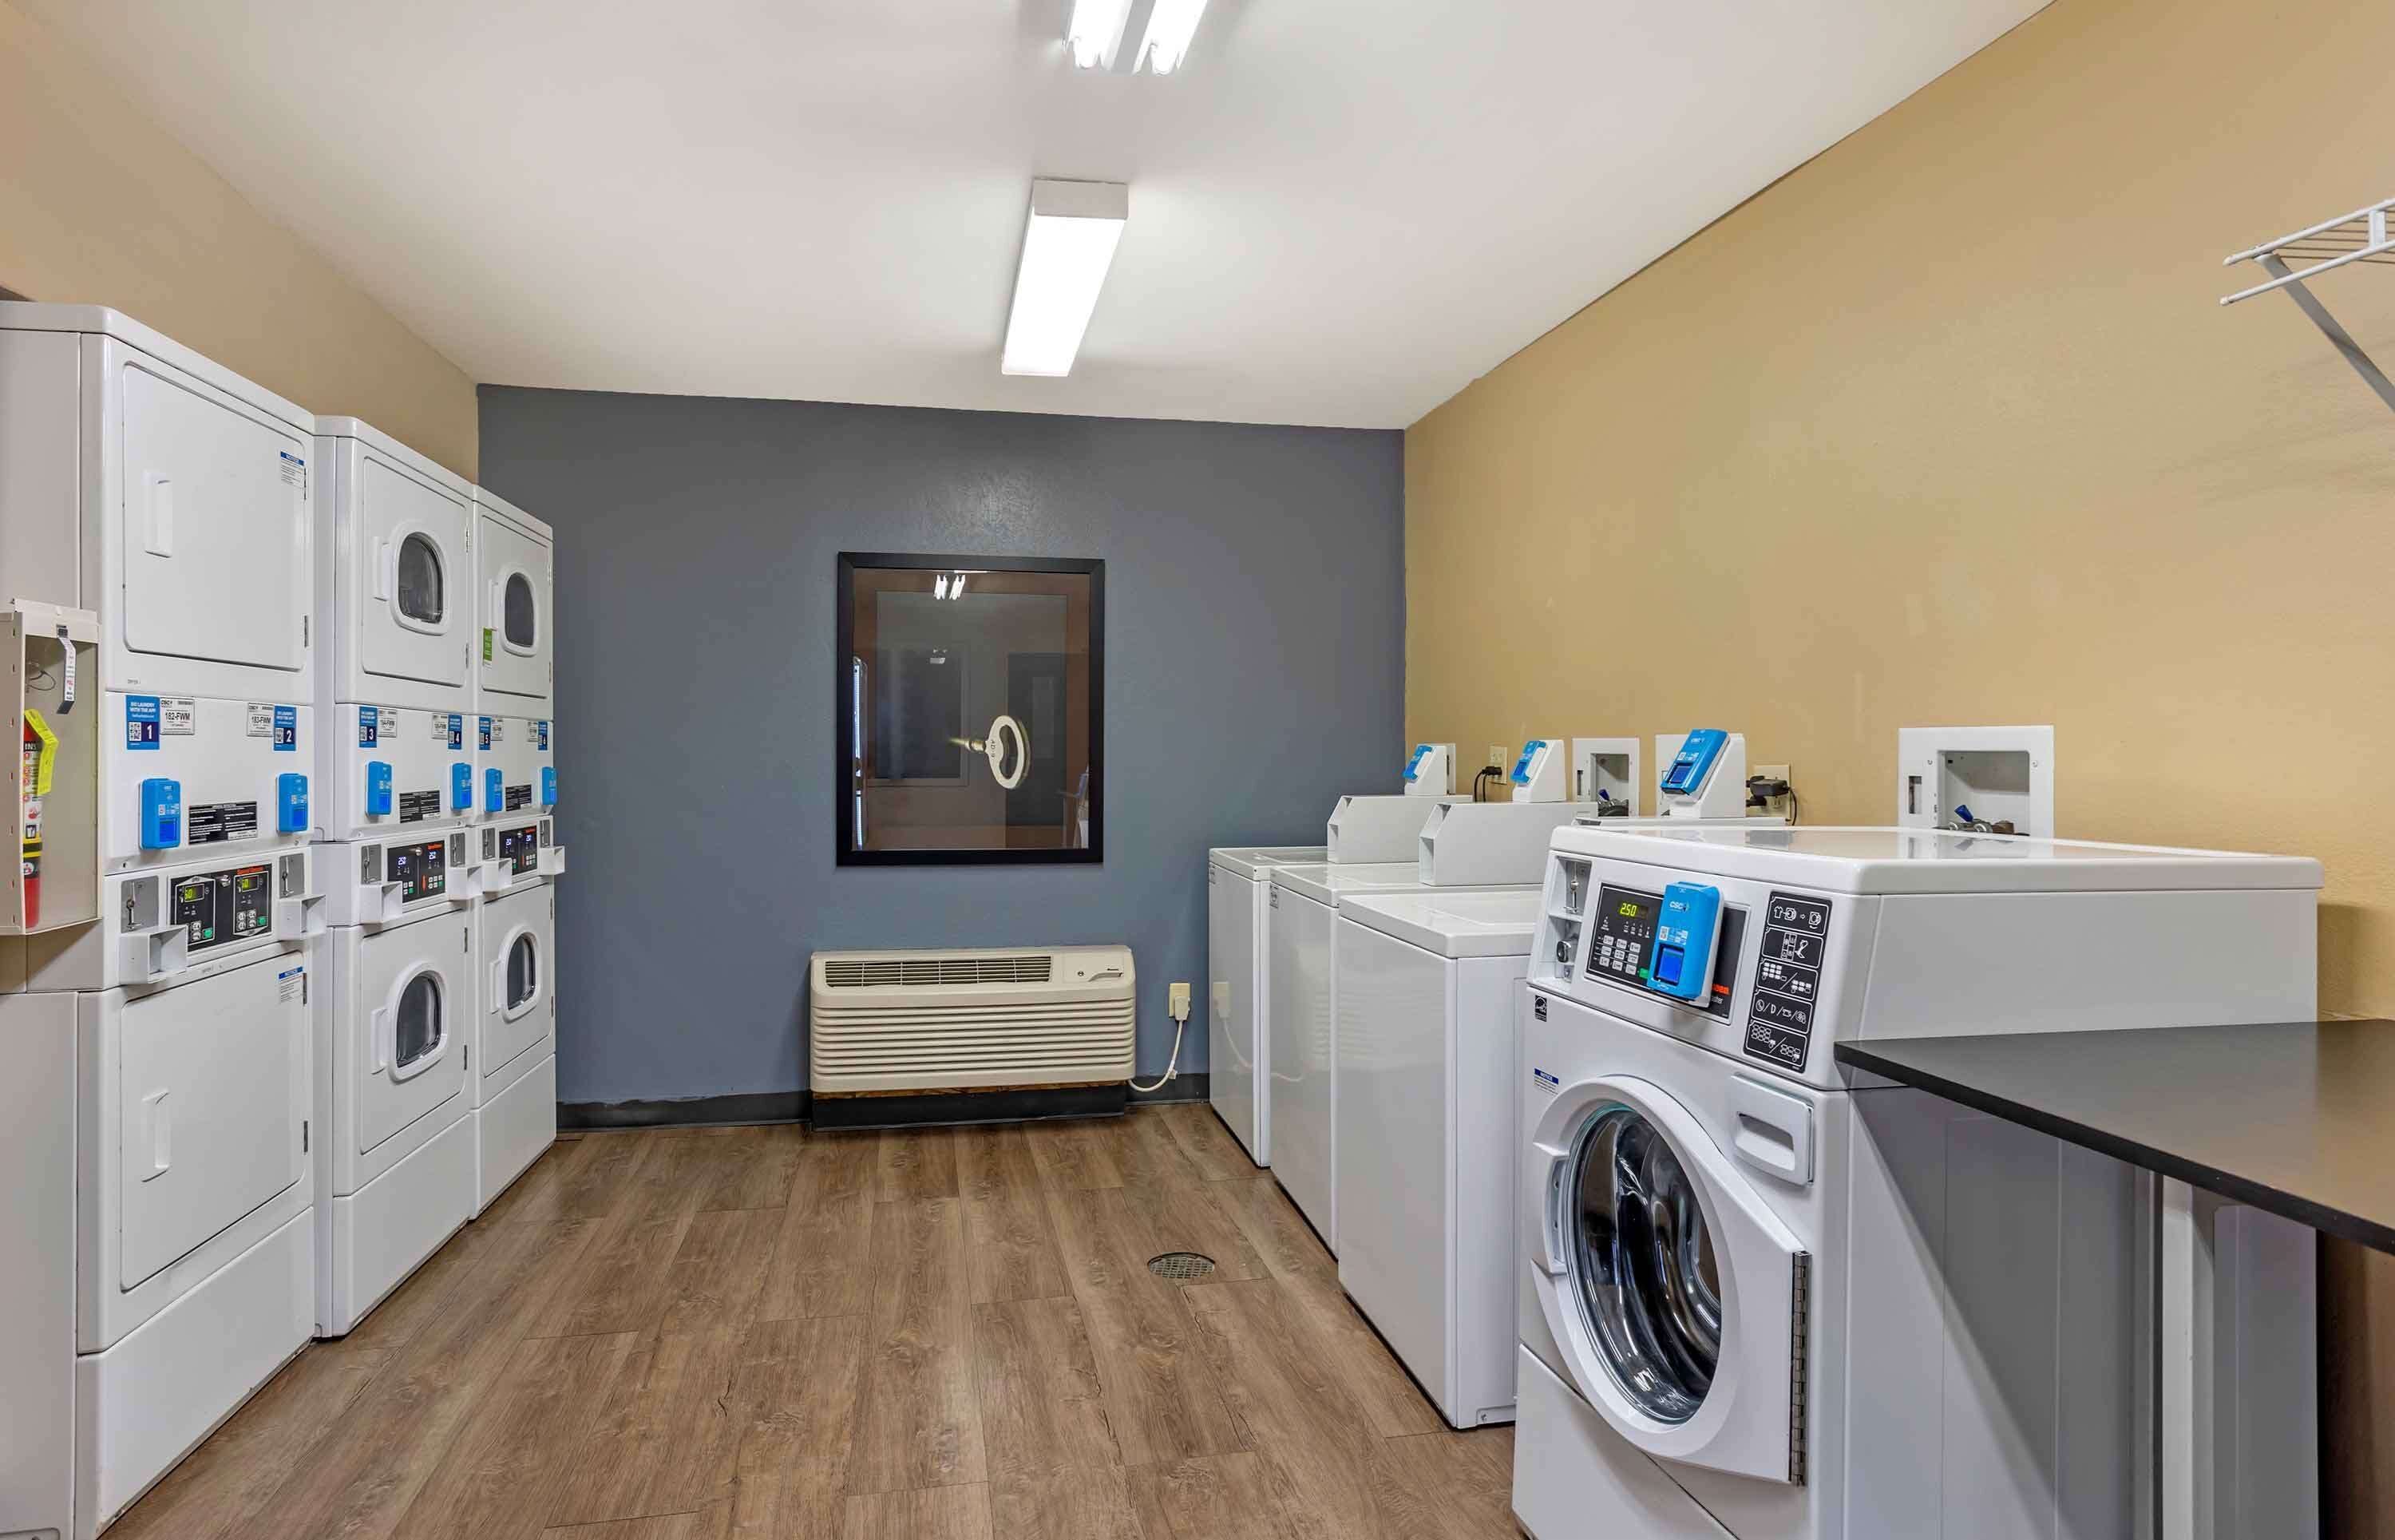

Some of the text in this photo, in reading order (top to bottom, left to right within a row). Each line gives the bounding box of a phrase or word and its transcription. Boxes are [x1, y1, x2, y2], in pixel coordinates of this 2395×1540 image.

[147, 724, 152, 739] 1
[286, 730, 292, 742] 2
[369, 728, 374, 741] 3
[455, 733, 460, 743] 4
[485, 734, 489, 744] 5
[1669, 901, 1684, 909] CSC
